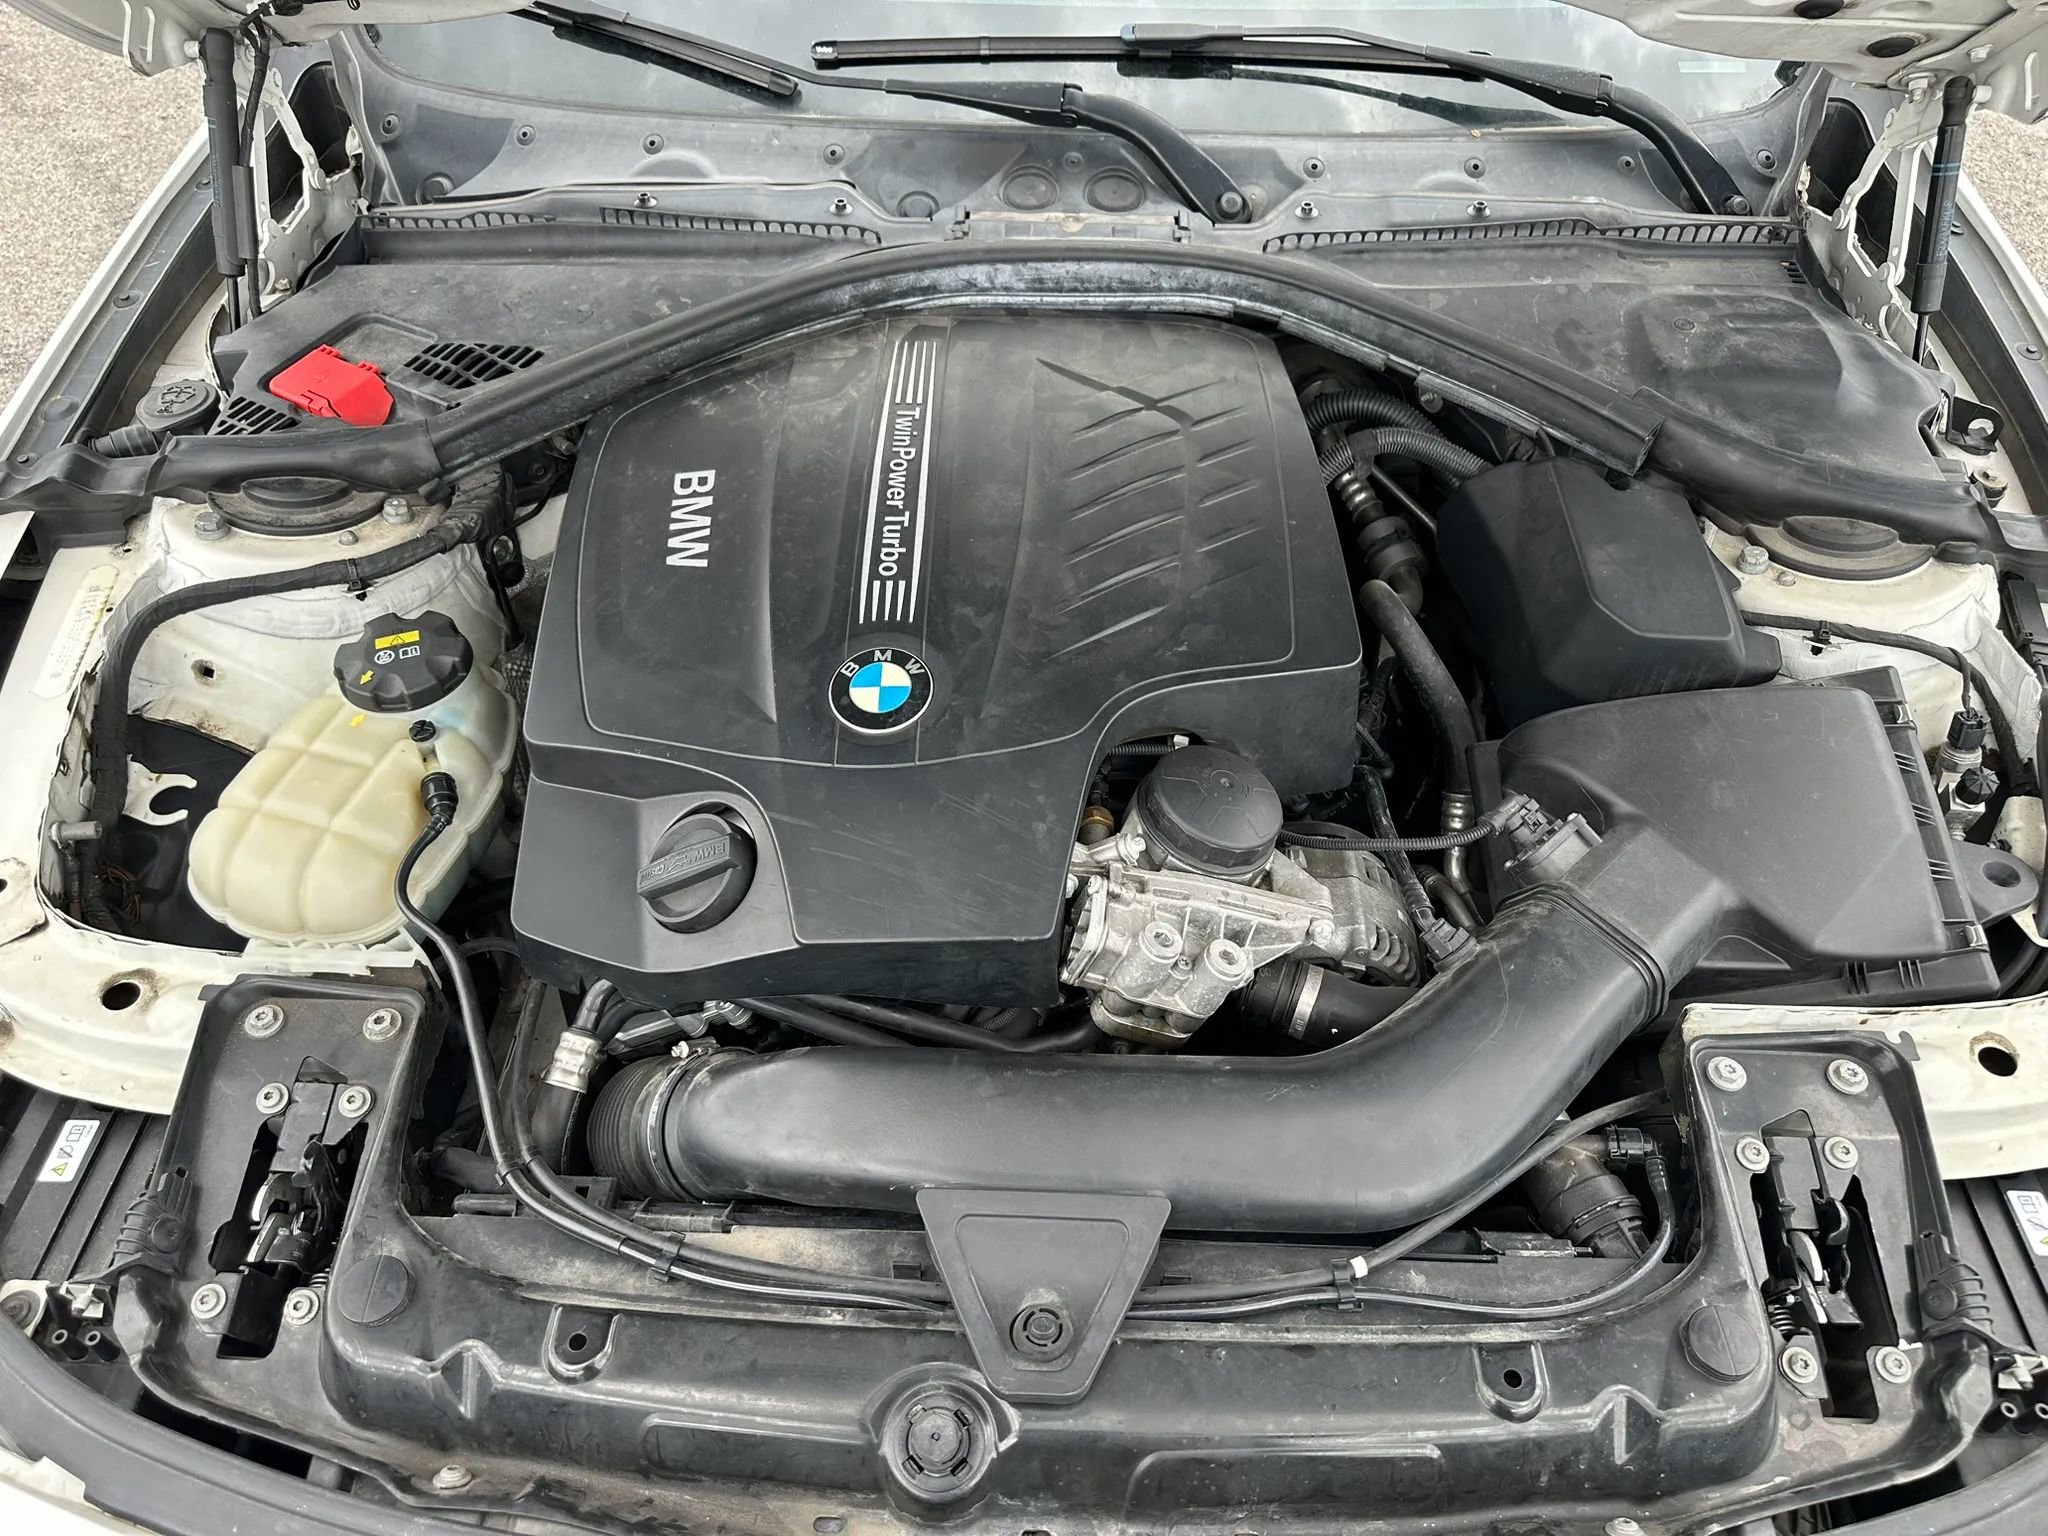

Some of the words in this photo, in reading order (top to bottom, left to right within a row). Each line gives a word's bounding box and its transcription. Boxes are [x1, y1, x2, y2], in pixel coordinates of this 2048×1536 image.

[885, 407, 921, 509] TwinPower
[665, 469, 716, 568] BMW
[878, 511, 911, 577] Turbo
[840, 649, 925, 678] BMW
[693, 842, 726, 862] BMW
